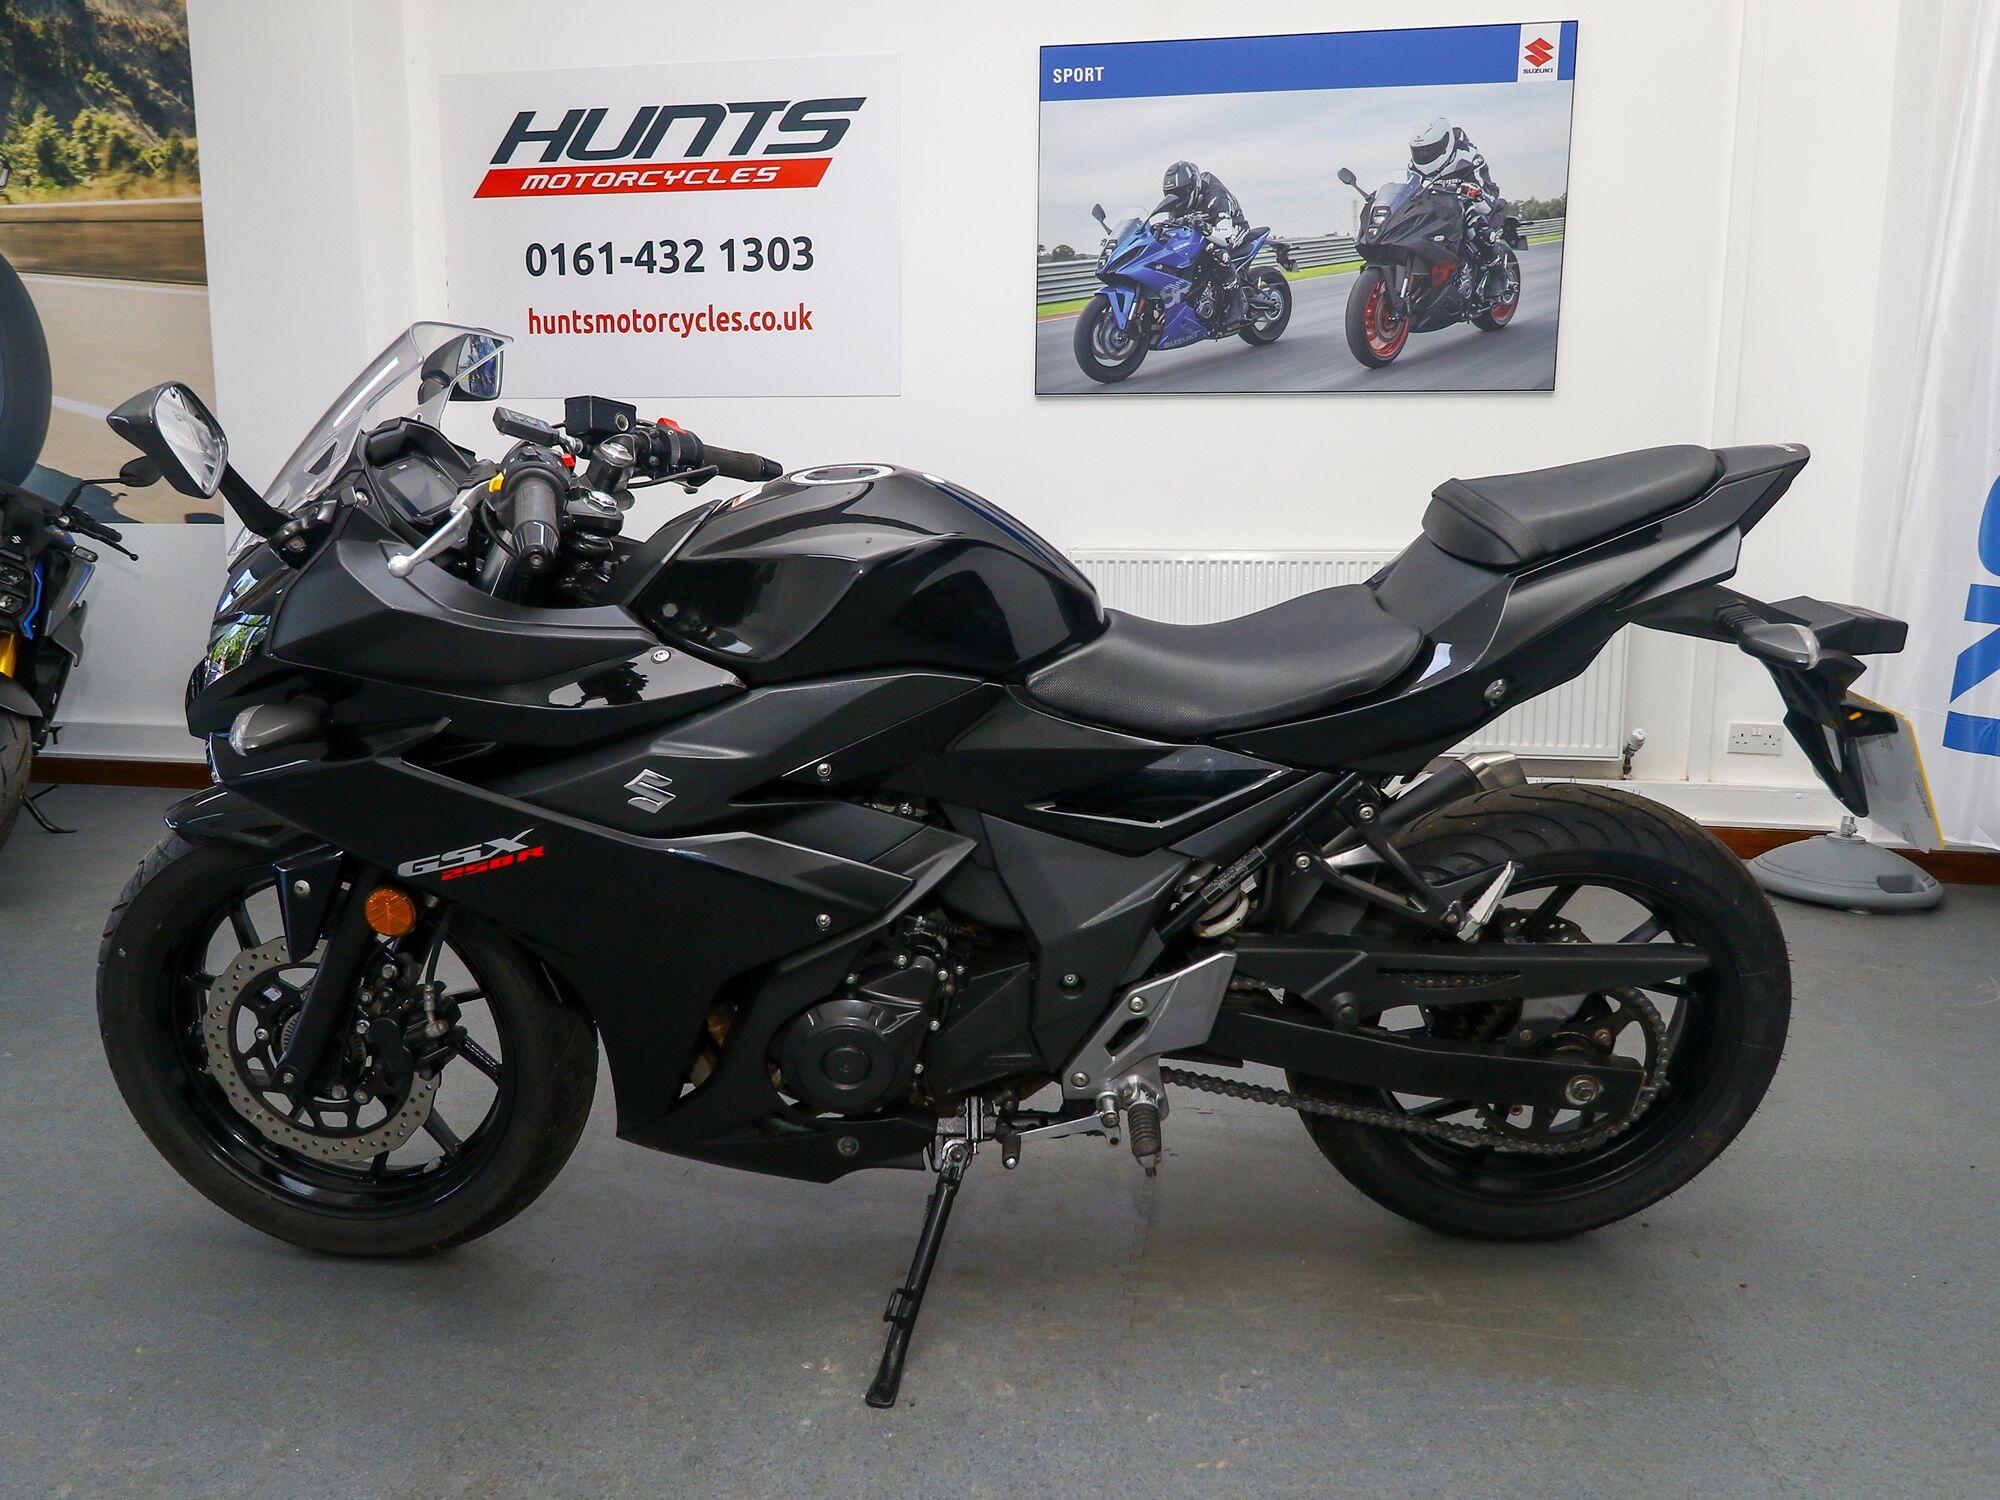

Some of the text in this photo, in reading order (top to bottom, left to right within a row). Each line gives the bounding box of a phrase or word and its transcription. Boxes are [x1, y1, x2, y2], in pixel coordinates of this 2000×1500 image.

[1053, 66, 1105, 83] SPORT
[490, 96, 867, 164] HUNTS
[520, 166, 781, 190] MOTORCYCLES
[525, 236, 814, 276] 0161-432 1303
[528, 303, 813, 338] huntsmotorcycles.co.uk
[398, 828, 534, 877] GSX
